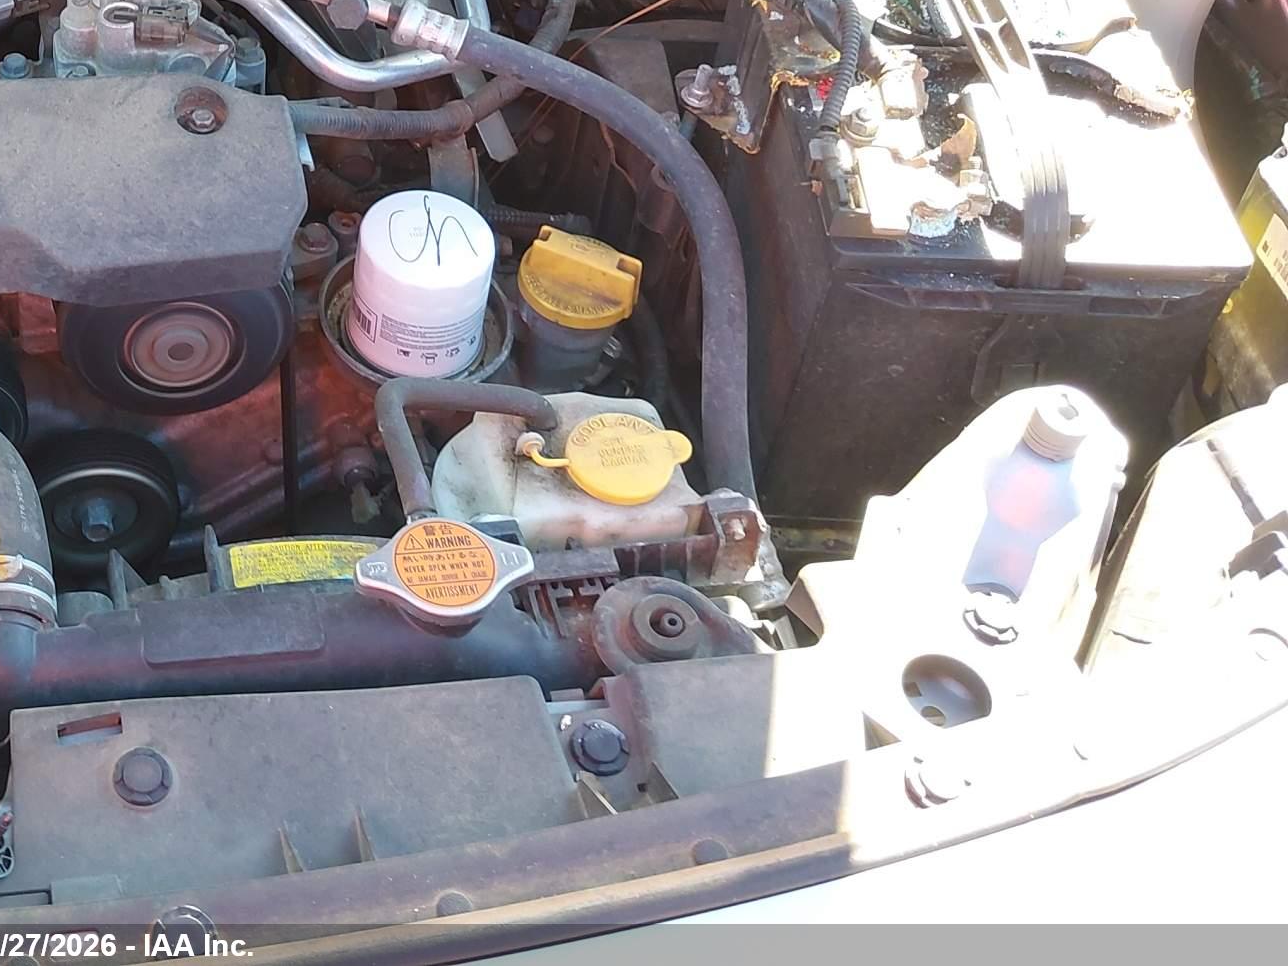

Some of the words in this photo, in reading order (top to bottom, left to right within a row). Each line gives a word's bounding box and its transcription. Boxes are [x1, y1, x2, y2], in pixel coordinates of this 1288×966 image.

[571, 416, 658, 447] COOLANT
[425, 535, 472, 549] WARNING
[404, 564, 426, 574] NEVER
[428, 563, 447, 572] OPEN
[449, 561, 469, 571] WHEN
[424, 583, 480, 600] AVERTISSMENT
